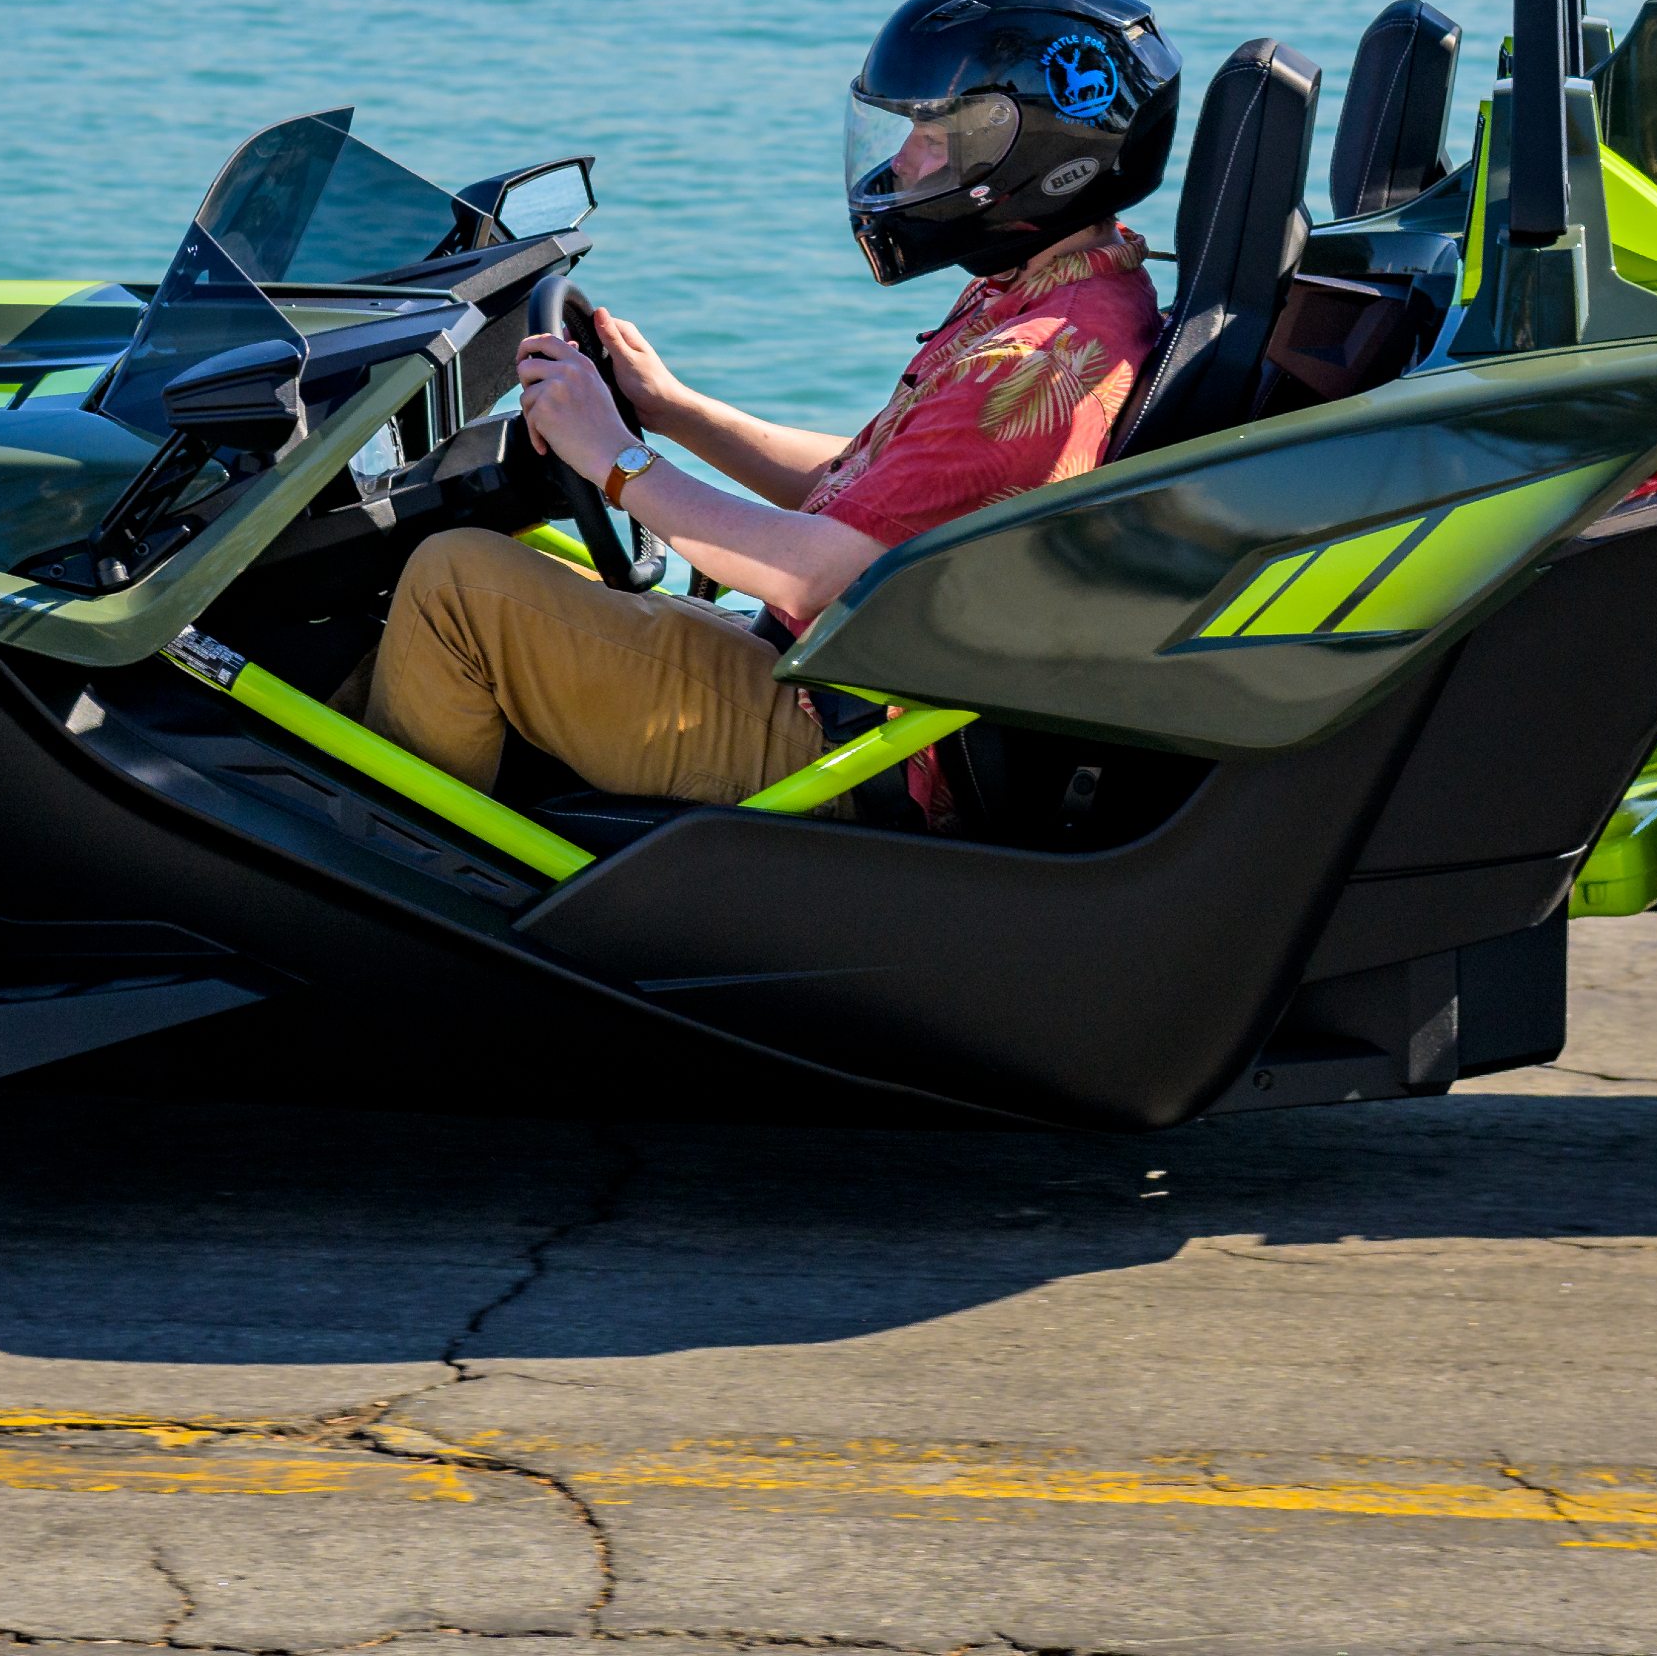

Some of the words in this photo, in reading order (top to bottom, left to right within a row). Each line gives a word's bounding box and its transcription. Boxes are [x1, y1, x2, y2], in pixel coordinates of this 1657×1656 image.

[1040, 34, 1079, 66] HARTLE
[1084, 35, 1107, 54] POOL
[1055, 111, 1096, 127] UNITED
[1050, 164, 1092, 190] BELL
